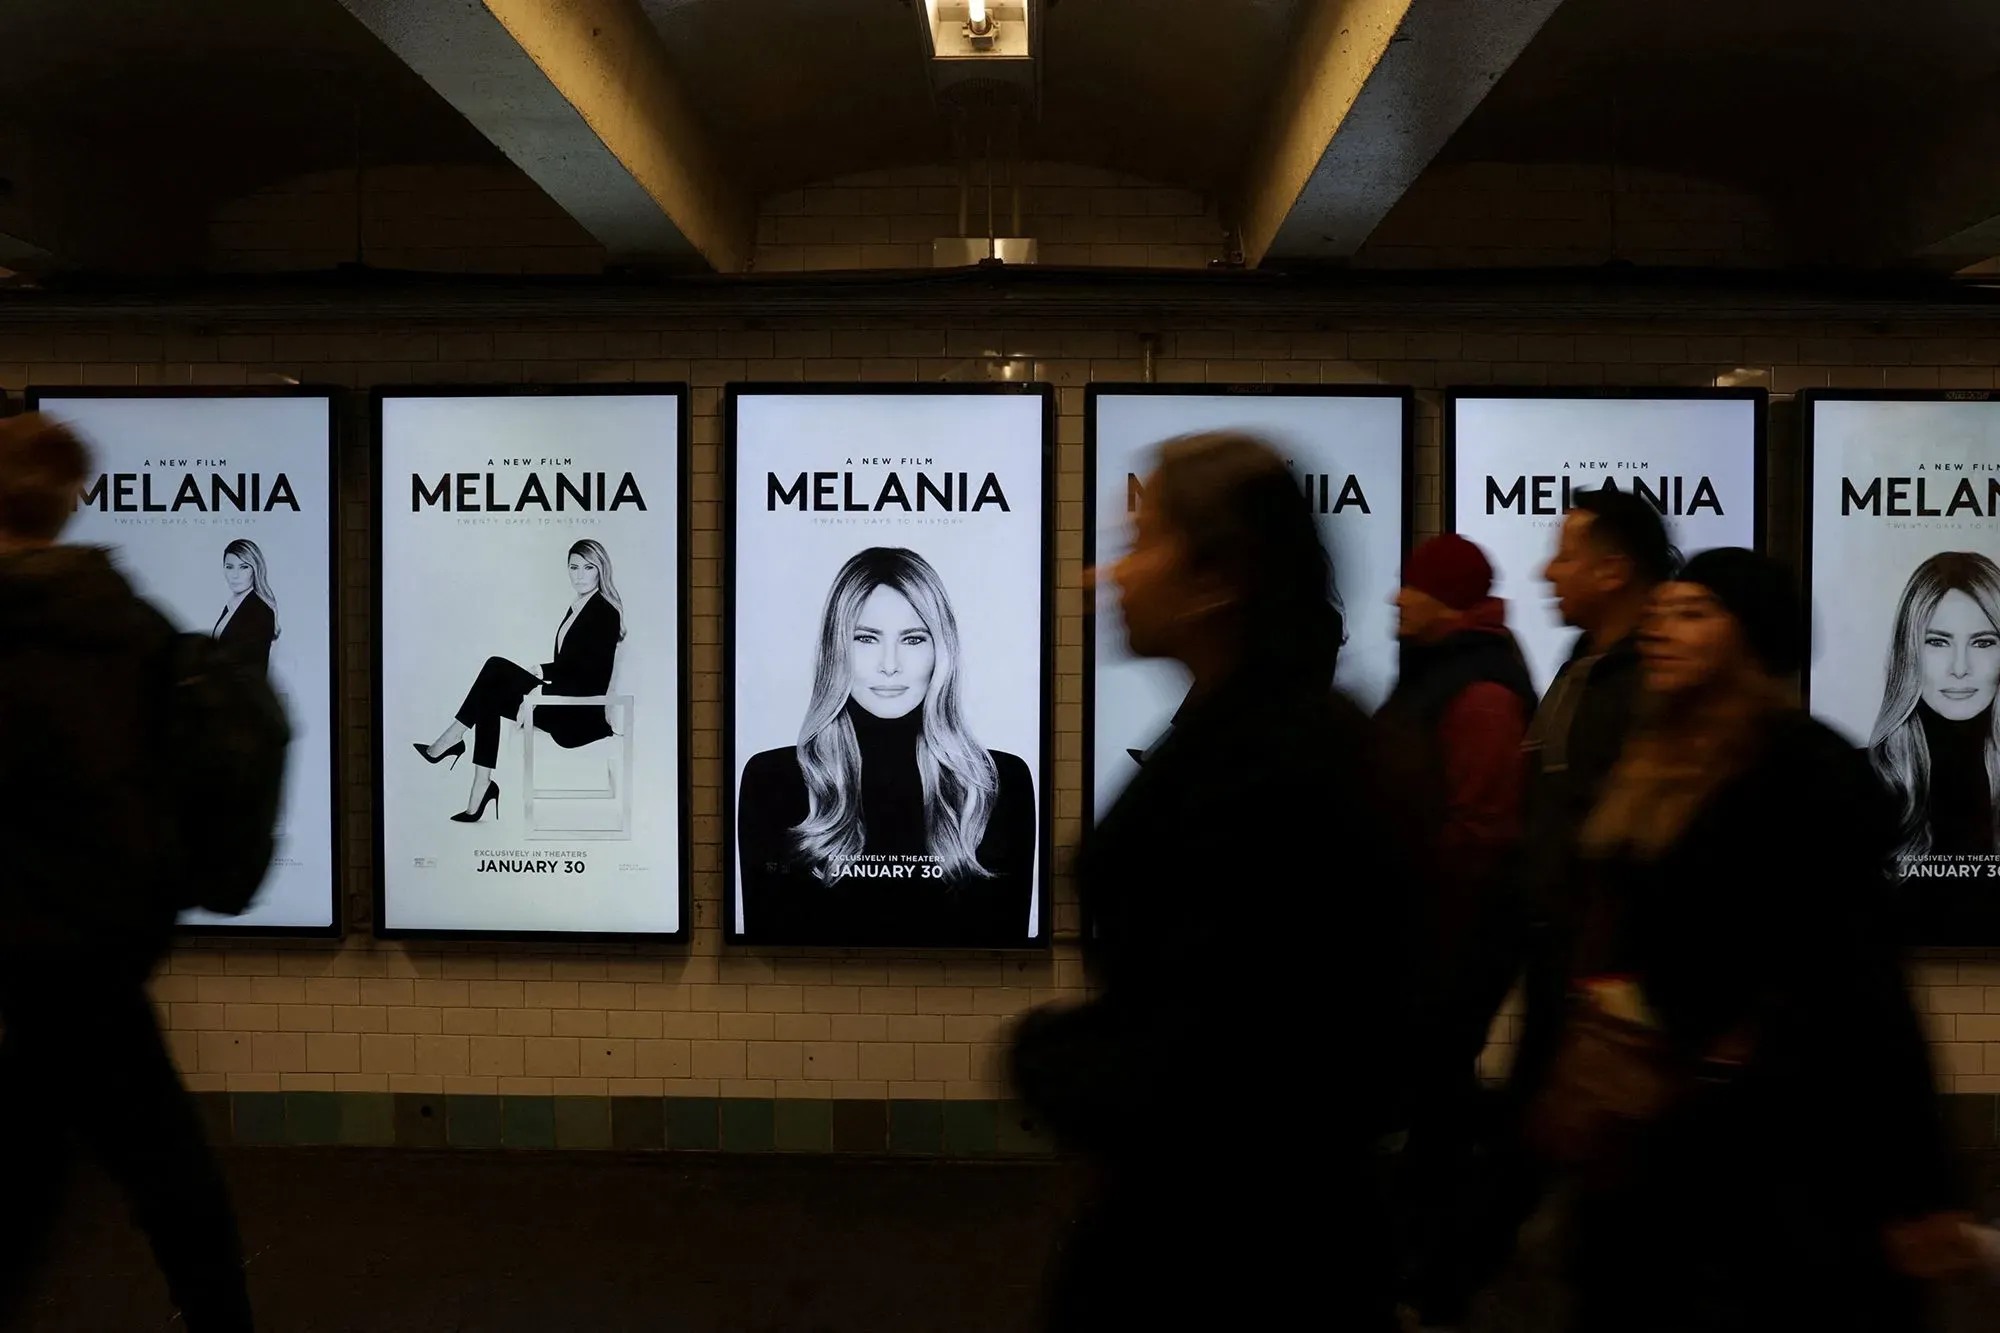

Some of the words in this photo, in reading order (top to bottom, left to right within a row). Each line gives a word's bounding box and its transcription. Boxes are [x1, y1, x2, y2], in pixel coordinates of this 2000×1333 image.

[144, 459, 151, 467] A
[160, 459, 188, 467] NEW
[196, 459, 227, 467] FILM
[487, 458, 495, 466] A
[504, 458, 532, 466] NEW
[541, 458, 572, 466] FILM
[846, 457, 853, 465] A
[863, 457, 892, 465] NEW
[901, 457, 933, 465] FILM
[1563, 461, 1571, 469] A
[1580, 461, 1609, 469] NEW
[1617, 461, 1649, 469] FILM
[1918, 463, 1926, 471] A
[1935, 463, 1964, 471] NEW
[412, 472, 648, 512] MELANIA
[767, 472, 1011, 512] MELANIA
[828, 854, 886, 862] EXCLUSIVELY
[901, 855, 945, 863] THEATERS
[476, 860, 558, 873] JANUARY
[563, 861, 586, 874] 30
[831, 864, 916, 878] JANUARY
[921, 865, 943, 879] 30
[1899, 865, 1981, 877] JANUARY
[1986, 865, 2000, 877] 3
